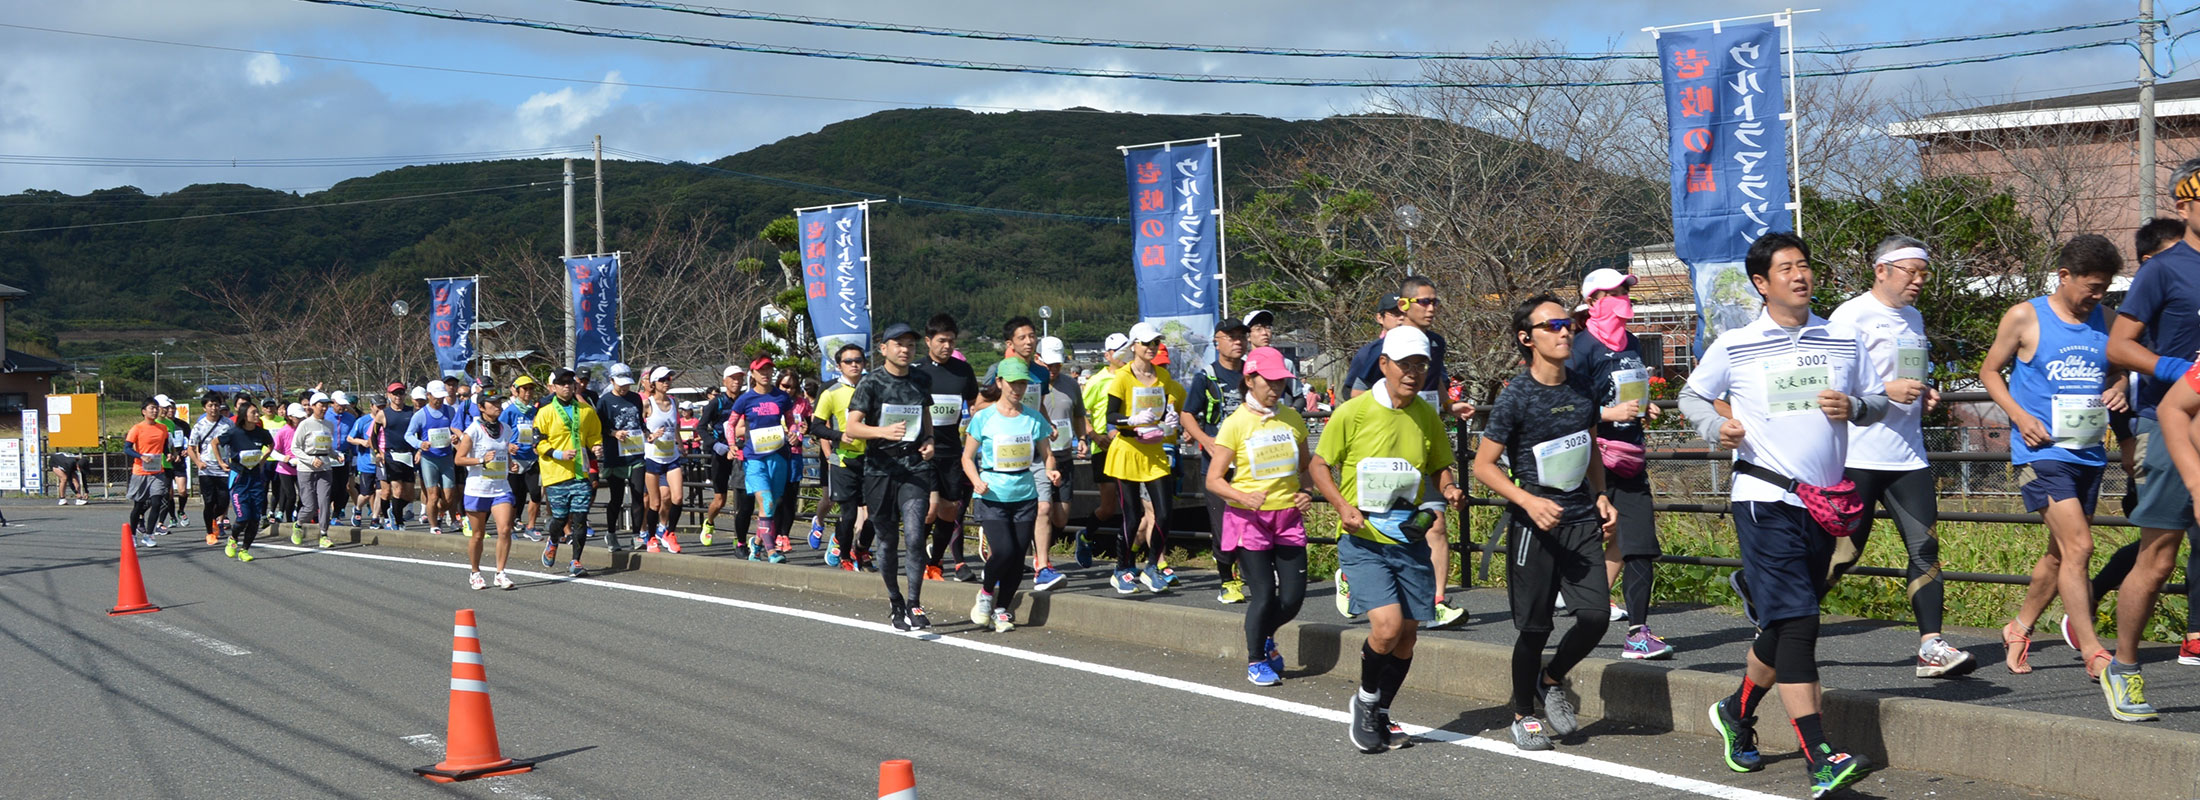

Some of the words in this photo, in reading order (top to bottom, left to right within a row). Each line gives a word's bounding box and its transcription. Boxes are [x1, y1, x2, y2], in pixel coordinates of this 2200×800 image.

[1797, 354, 1828, 367] 3002
[2046, 360, 2105, 381] Rookie
[933, 406, 955, 414] 3016
[1015, 435, 1030, 443] 4040
[1272, 433, 1291, 442] 4004
[1564, 434, 1588, 449] 3028
